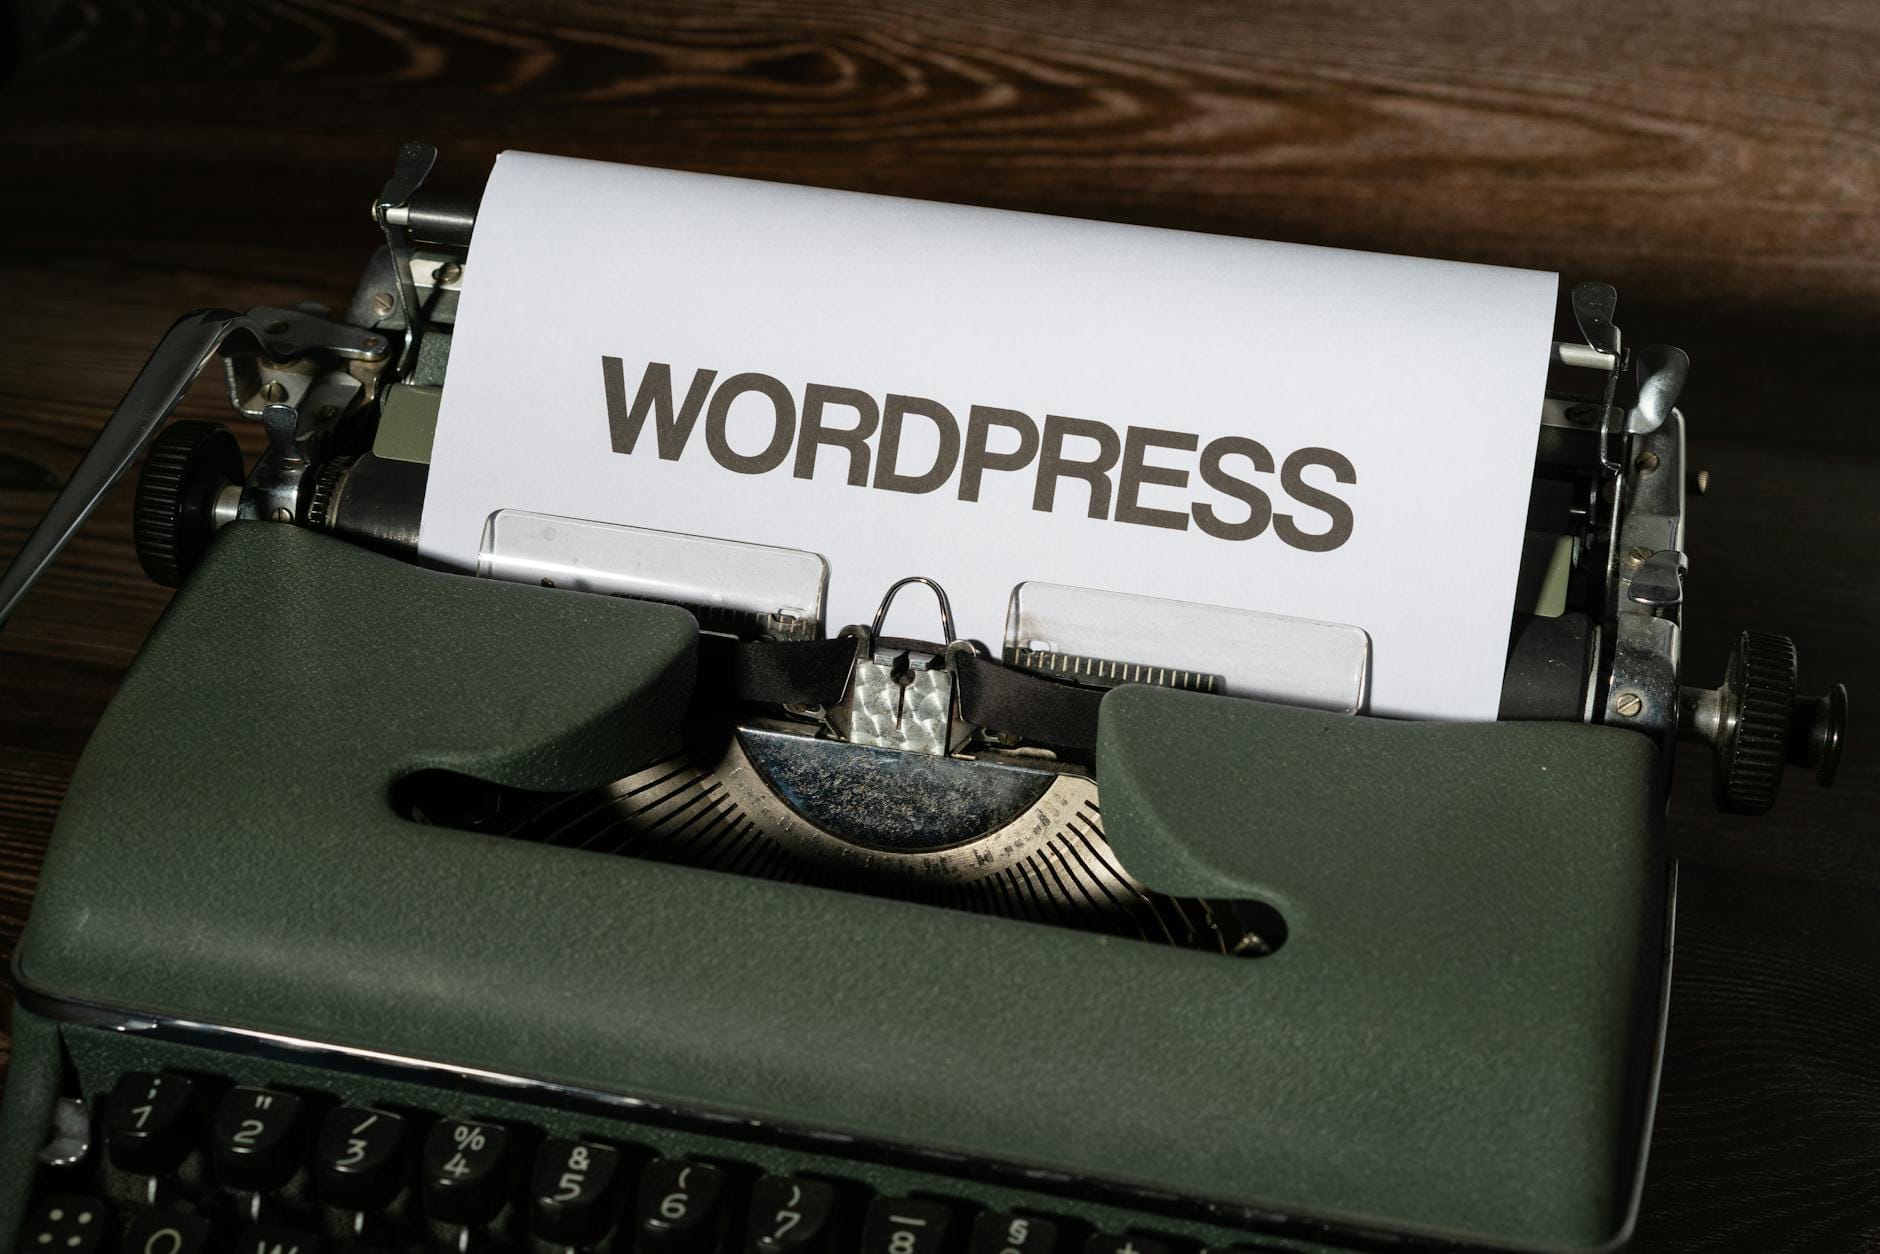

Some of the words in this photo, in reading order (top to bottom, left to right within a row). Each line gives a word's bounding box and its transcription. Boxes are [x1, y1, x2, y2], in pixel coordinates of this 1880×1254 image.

[602, 356, 1356, 553] WORDPRESS
[232, 1119, 264, 1144] 2
[453, 1125, 486, 1151] %
[335, 1138, 368, 1166] 3
[443, 1152, 470, 1178] 4
[567, 1146, 591, 1171] &
[552, 1173, 584, 1201] 5
[678, 1166, 691, 1189] (
[660, 1192, 689, 1219] 6
[786, 1185, 802, 1207] )
[774, 1209, 802, 1239] 7
[1007, 1219, 1030, 1245] §
[888, 1230, 916, 1254] 8
